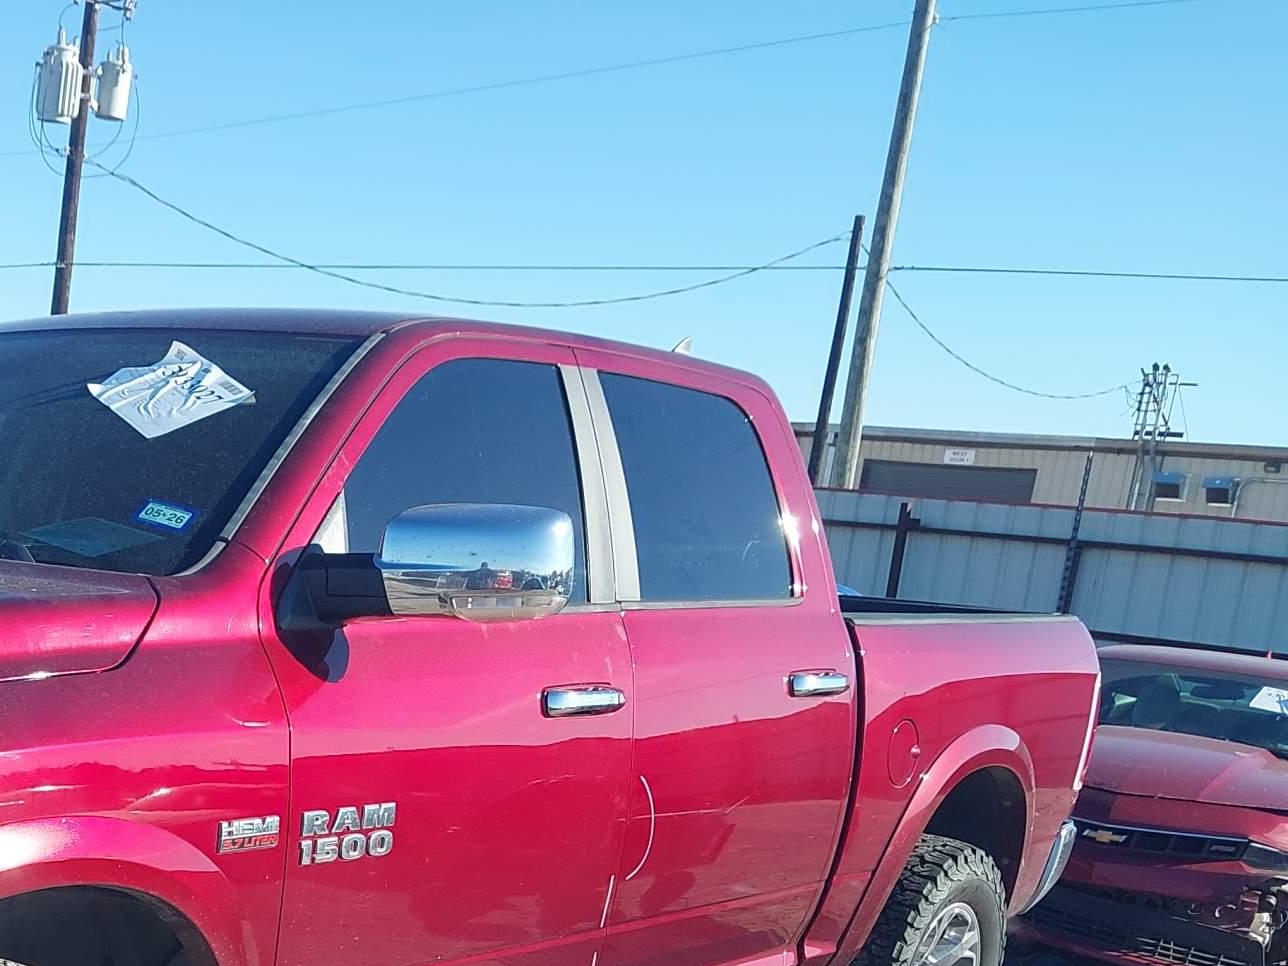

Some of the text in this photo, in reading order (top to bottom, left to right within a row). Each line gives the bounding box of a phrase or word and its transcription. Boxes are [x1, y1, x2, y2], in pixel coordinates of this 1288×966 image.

[221, 815, 280, 838] HEMI
[301, 801, 397, 837] RAM
[300, 829, 394, 866] 1500
